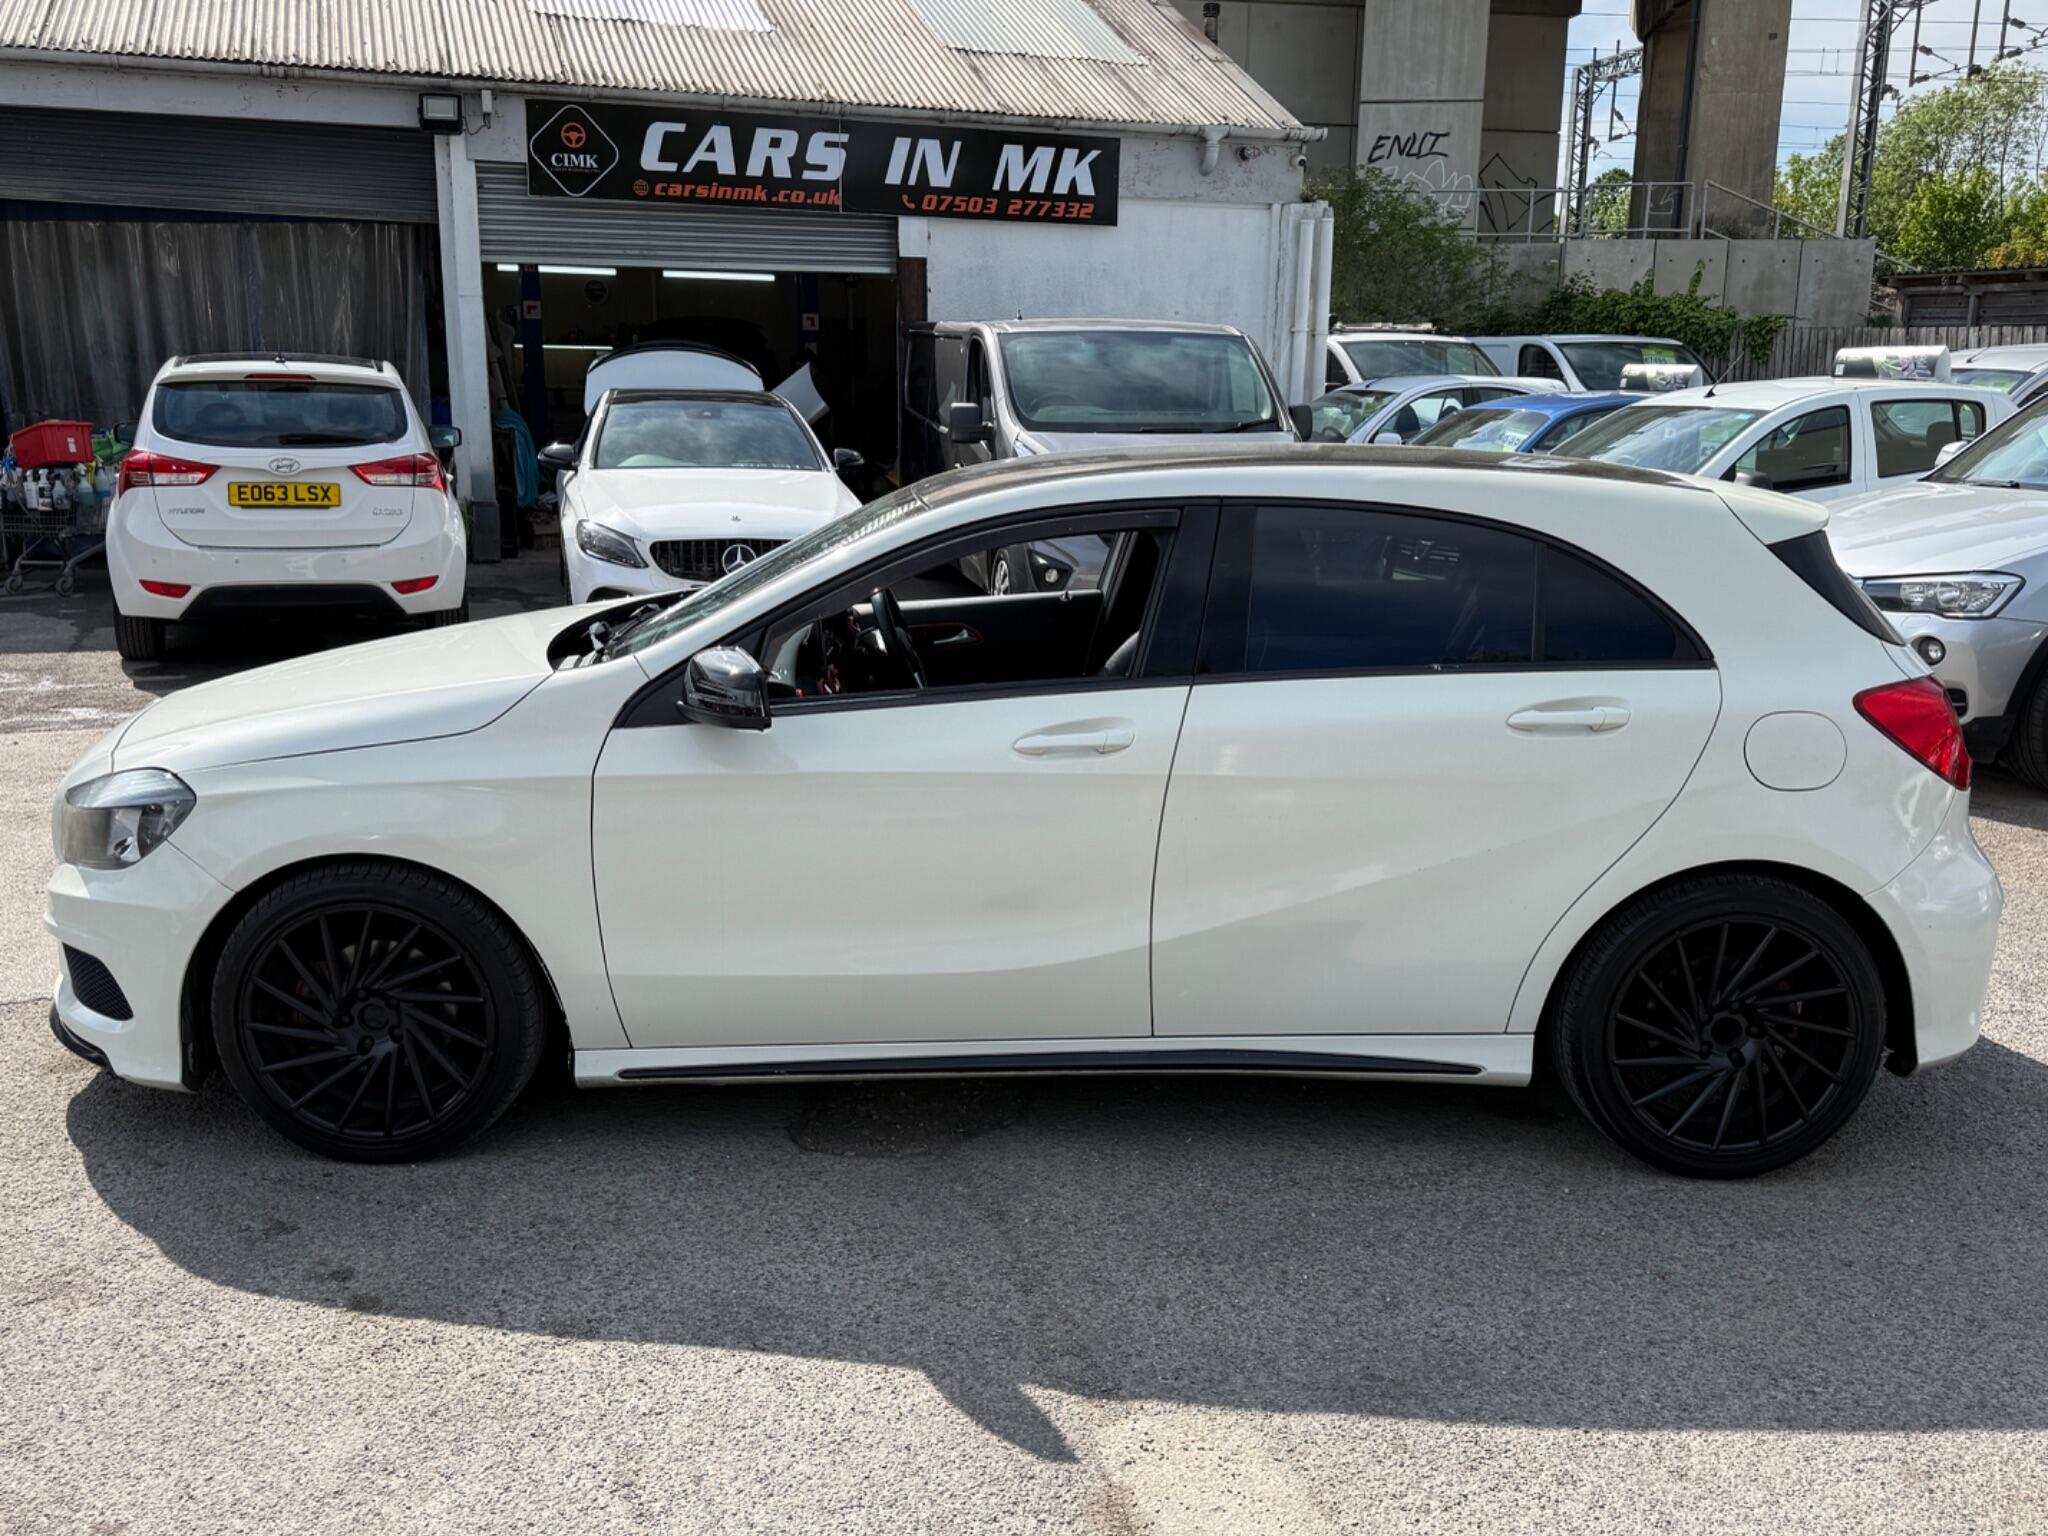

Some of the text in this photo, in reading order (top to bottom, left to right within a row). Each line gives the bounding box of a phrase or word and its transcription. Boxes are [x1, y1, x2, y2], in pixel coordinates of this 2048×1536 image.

[551, 152, 599, 168] CIMK
[640, 121, 1102, 196] CARS IN MK
[654, 182, 841, 205] carsinmk.co.uk
[922, 193, 1095, 219] 07503 277332
[237, 484, 333, 502] EO63 LSX
